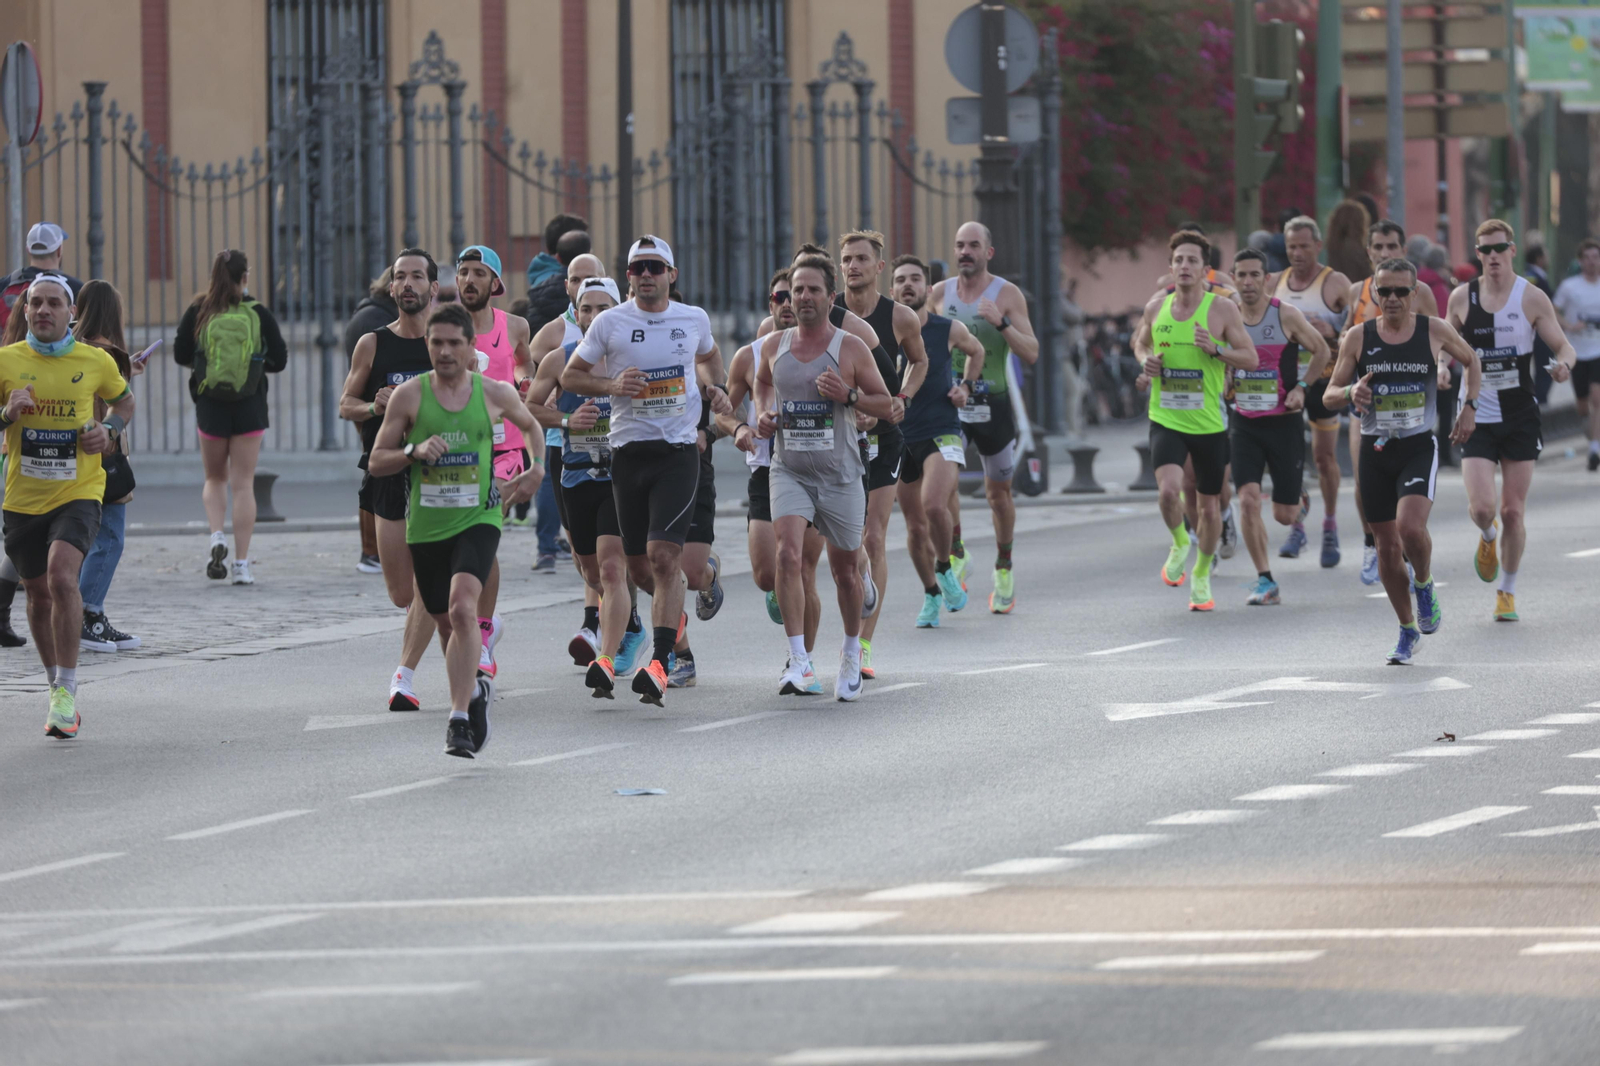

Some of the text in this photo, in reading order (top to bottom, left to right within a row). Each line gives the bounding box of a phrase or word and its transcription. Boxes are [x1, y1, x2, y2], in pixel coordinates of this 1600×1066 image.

[1484, 349, 1512, 357] ZURICH
[1392, 362, 1429, 374] KACHOPOS
[648, 368, 678, 380] ZURICH
[1172, 370, 1199, 378] ZURICH
[649, 386, 668, 395] 3737
[1390, 384, 1420, 393] ZURICH
[40, 398, 76, 406] MARATON
[642, 397, 677, 406] ANDRÉ VAZ
[21, 404, 76, 418] SEVILLA
[796, 403, 827, 411] ZURICH
[39, 432, 72, 440] ZURICH
[440, 430, 468, 442] GUÍA
[39, 448, 59, 457] 1963
[30, 459, 53, 467] AKRAM
[438, 455, 472, 464] ZURICH
[439, 473, 459, 482] 1142
